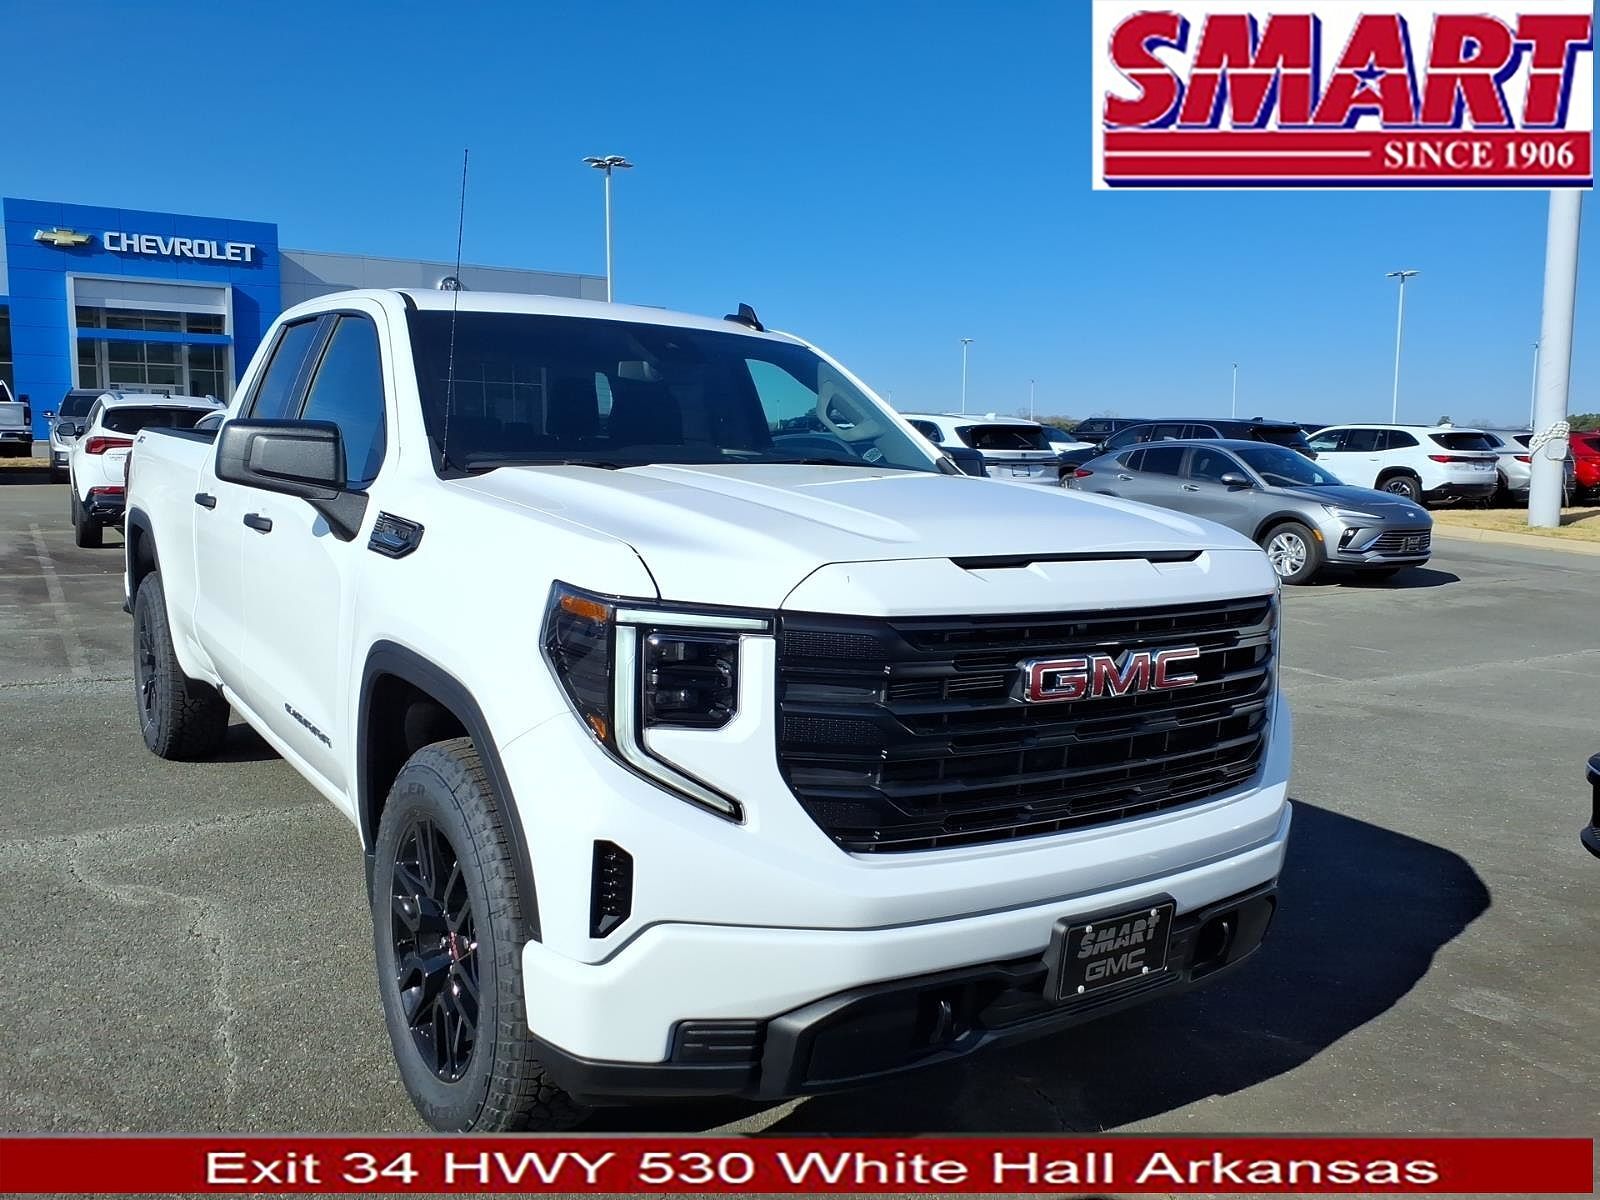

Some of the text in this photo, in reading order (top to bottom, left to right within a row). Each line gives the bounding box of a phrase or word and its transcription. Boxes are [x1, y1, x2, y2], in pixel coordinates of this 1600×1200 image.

[103, 231, 256, 262] CHEVROLET
[1022, 646, 1200, 704] GMC
[1077, 914, 1160, 959] SMART
[1084, 947, 1146, 981] GMC
